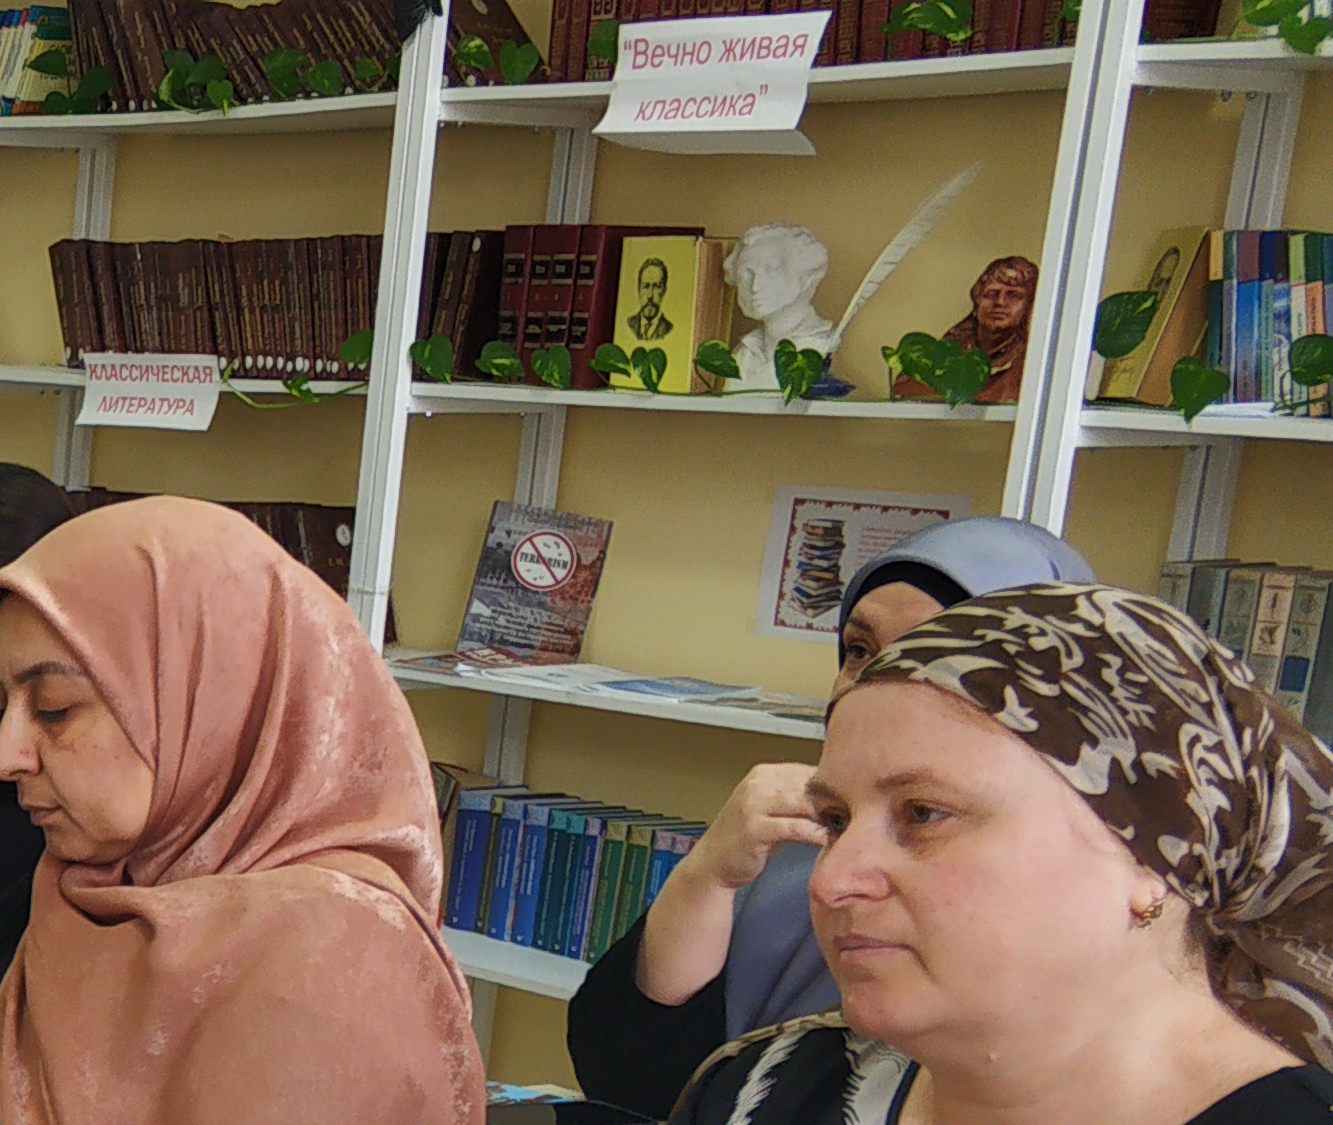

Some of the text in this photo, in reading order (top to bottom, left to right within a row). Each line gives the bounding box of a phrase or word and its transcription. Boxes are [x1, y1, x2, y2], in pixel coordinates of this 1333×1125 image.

[718, 33, 809, 63] живая
[88, 363, 214, 384] КЛАССИЧЕСКАЯ
[96, 395, 196, 417] ЛИТЕРАТУРА
[520, 551, 569, 570] TERRRISM
